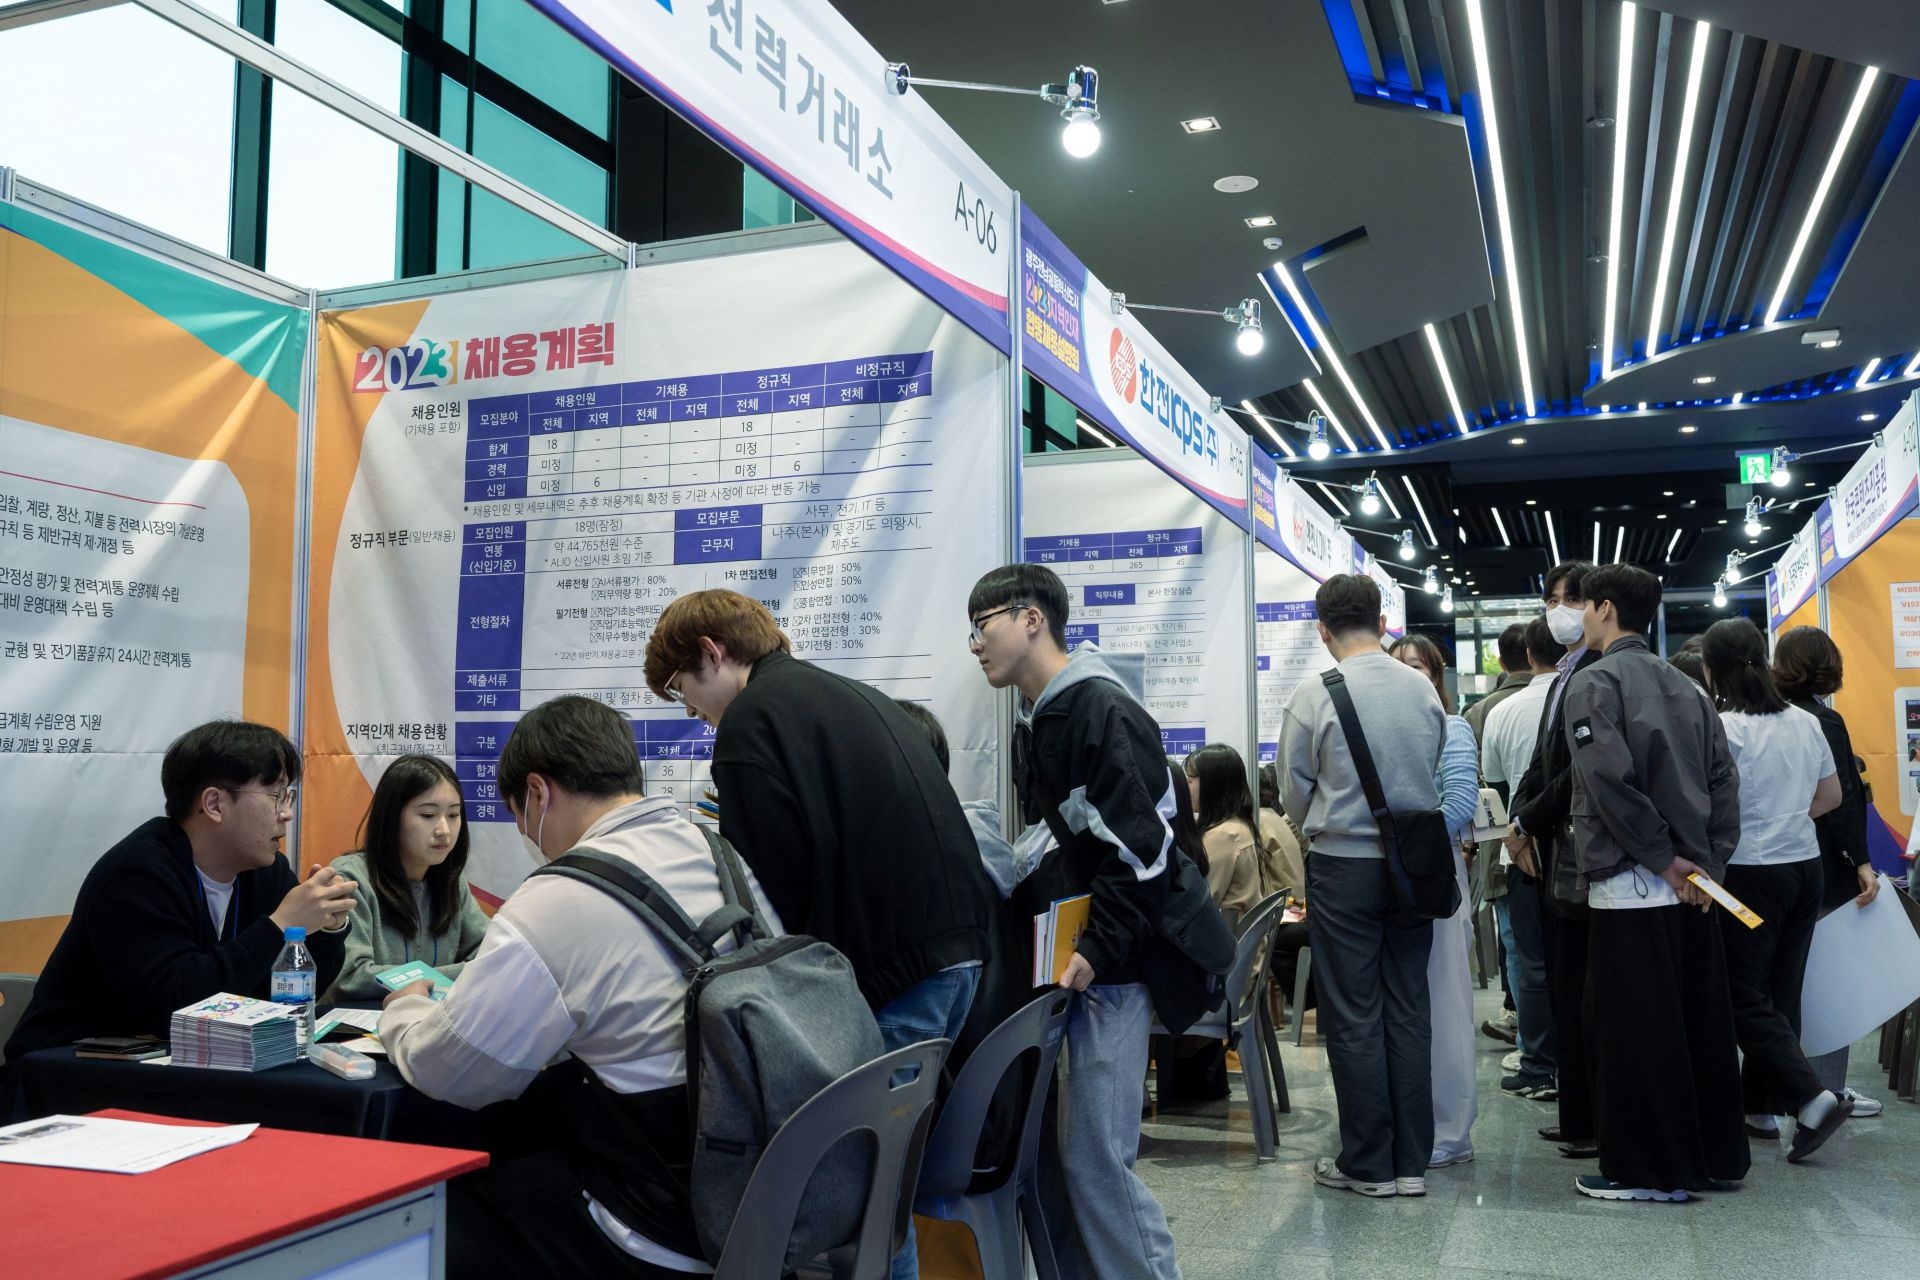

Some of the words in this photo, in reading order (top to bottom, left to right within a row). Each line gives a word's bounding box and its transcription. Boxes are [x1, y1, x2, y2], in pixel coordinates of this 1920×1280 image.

[707, 0, 893, 200] 전력거래소
[955, 181, 996, 254] A-06
[356, 340, 455, 392] 2023
[464, 322, 615, 380] 채용계획
[855, 361, 905, 377] 비정규직
[757, 374, 791, 387] 정규직
[655, 383, 689, 397] 기채용
[840, 386, 864, 401] 전체
[897, 381, 919, 396] 지역
[554, 392, 596, 408] 채용인원
[736, 398, 759, 412] 전체
[788, 392, 811, 407] 지역
[411, 401, 461, 419] 채용인원
[636, 408, 657, 421] 전체
[685, 403, 708, 416] 지역
[479, 410, 519, 427] 모집분야
[542, 416, 563, 430] 전체
[588, 411, 609, 426] 지역
[741, 421, 753, 433] 18
[488, 442, 508, 455] 합계
[547, 439, 558, 451] 18
[735, 442, 758, 456] 미정
[487, 462, 508, 477] 경력
[541, 459, 561, 472] 미정
[735, 464, 757, 477] 미정
[793, 460, 801, 471] 6
[540, 479, 560, 493] 미정
[593, 476, 601, 488] 6
[486, 482, 507, 497] 신입
[473, 505, 511, 518] 채용인원
[515, 504, 524, 515] 및
[527, 500, 575, 513] 세부내역은
[579, 497, 599, 510] 추후
[603, 494, 644, 508] 채용계획
[647, 492, 668, 506] 확정
[672, 491, 682, 503] 등
[686, 488, 706, 502] 기관
[710, 485, 743, 501] 사정에
[746, 484, 768, 497] 따라
[771, 482, 793, 496] 변동
[797, 479, 821, 494] 가능
[805, 504, 833, 518] 사무,
[875, 498, 886, 512] 등
[26, 500, 53, 520] 계량,
[57, 504, 81, 525] 정산,
[85, 510, 104, 529] 지불
[106, 514, 116, 531] 등
[119, 517, 176, 537] 전력시장의
[697, 510, 740, 525] 모집부문
[475, 525, 514, 540] 모집인원
[575, 518, 623, 533] 18명(잠정)
[772, 524, 829, 540] 나주(본사)
[832, 523, 842, 537] 및
[846, 519, 878, 536] 경기도
[23, 523, 34, 541] 등
[38, 526, 82, 549] 제반규칙
[122, 540, 134, 555] 등
[350, 531, 385, 549] 정규직
[554, 541, 565, 552] 약
[623, 537, 644, 550] 수준
[701, 537, 734, 553] 근무지
[831, 537, 862, 552] 제주도
[484, 544, 503, 558] 연봉
[574, 553, 610, 567] 신입사원
[634, 551, 653, 564] 기준
[1129, 561, 1143, 569] 265
[469, 559, 517, 574] (신입기준)
[841, 562, 862, 573] 50%
[647, 575, 667, 584] 80%
[724, 570, 737, 580] 1차
[739, 568, 777, 580] 면접전형
[841, 575, 862, 586] 50%
[37, 572, 57, 591] 평가
[60, 576, 71, 593] 및
[74, 578, 124, 597] 전력계통
[128, 581, 159, 601] 운영계획
[161, 586, 180, 603] 수립
[556, 578, 589, 590] 서류전형
[634, 587, 651, 598] 평가
[658, 587, 677, 597] 20%
[841, 594, 868, 605] 100%
[24, 595, 68, 617] 운영대책
[71, 600, 98, 618] 수립
[102, 602, 114, 618] 등
[556, 608, 588, 619] 필기전형
[470, 615, 511, 629] 전형절차
[813, 612, 850, 624] 면접전형
[860, 612, 882, 622] 40%
[811, 625, 849, 637] 면접전형
[859, 625, 881, 635] 30%
[842, 639, 864, 649] 30%
[33, 643, 47, 660] 및
[118, 649, 151, 666] 24시간
[153, 651, 192, 668] 전력계통
[467, 673, 508, 687] 제출서류
[476, 693, 497, 707] 기타
[606, 693, 616, 706] 및
[620, 691, 641, 704] 절차
[644, 692, 654, 704] 등
[80, 714, 102, 731] 지원
[346, 723, 394, 740] 지역인재
[476, 736, 496, 749] 구분
[476, 764, 496, 777] 합계
[662, 765, 674, 776] 36
[476, 785, 496, 798] 신입
[476, 805, 496, 818] 경력
